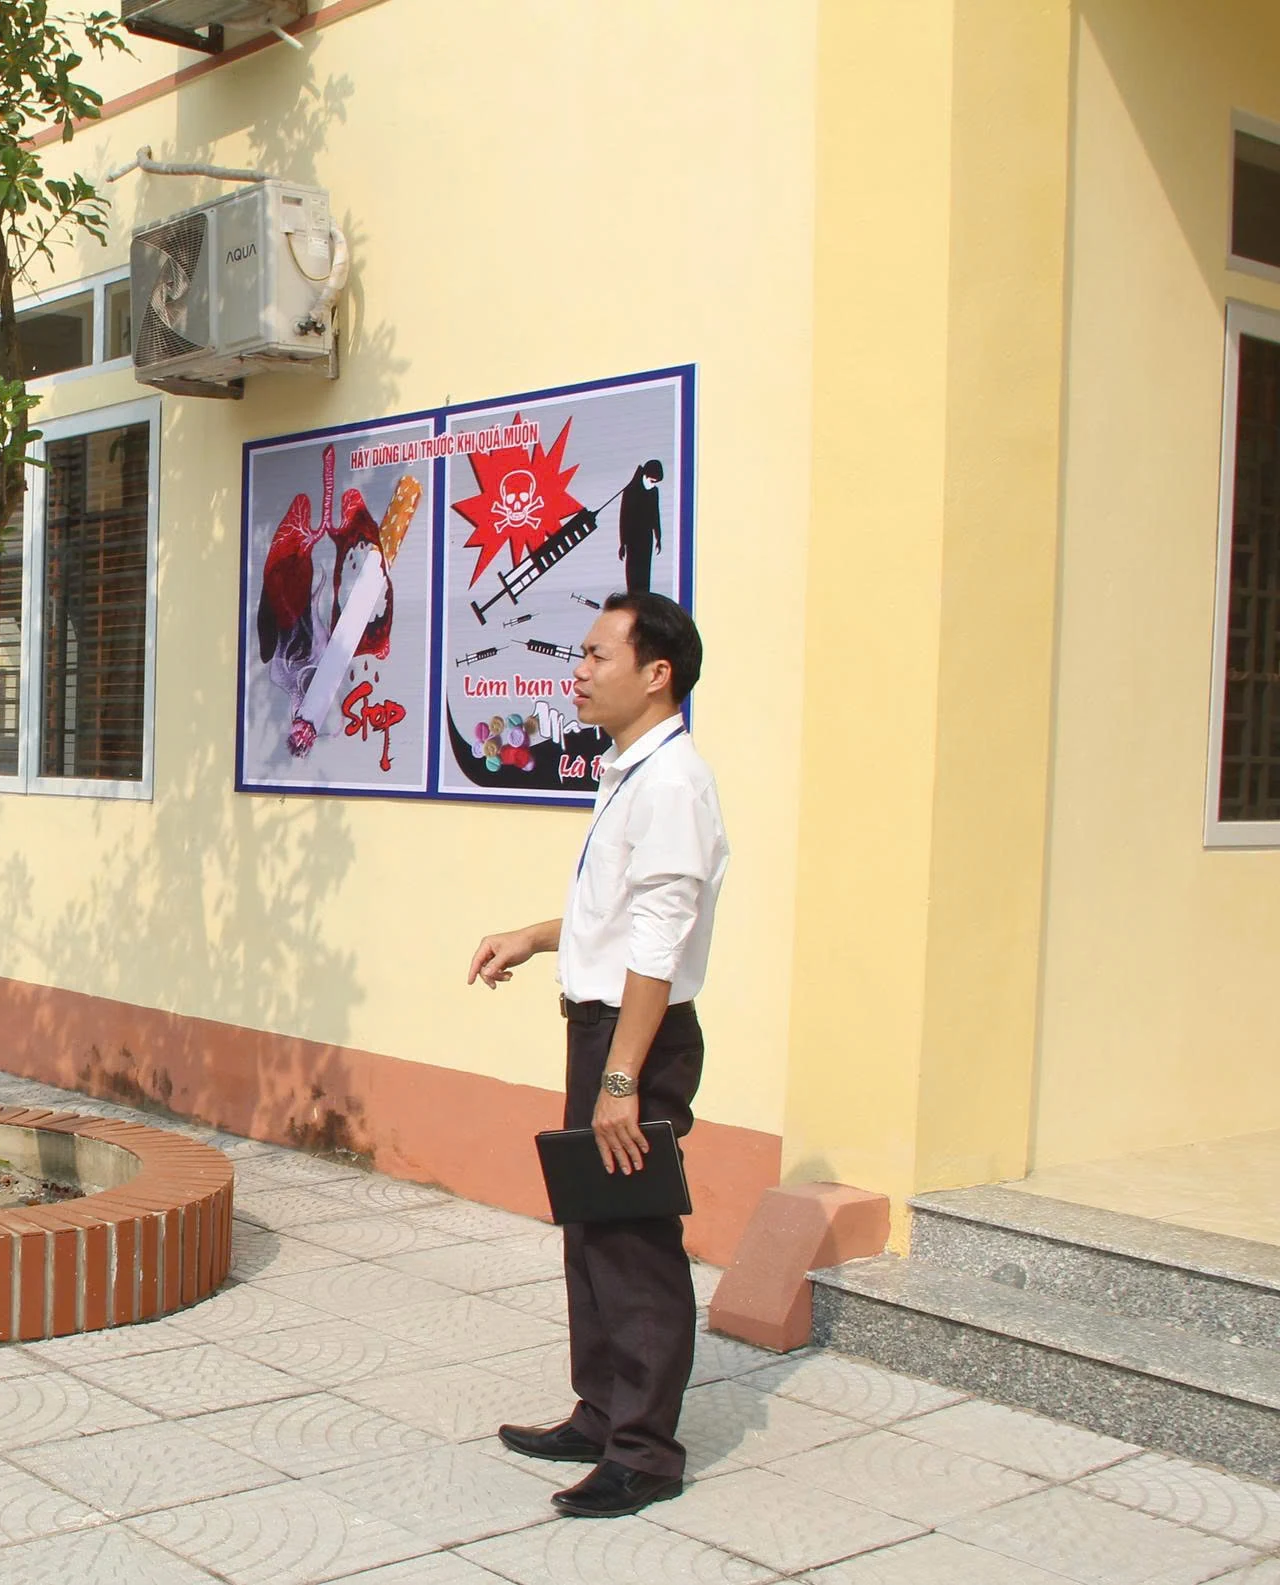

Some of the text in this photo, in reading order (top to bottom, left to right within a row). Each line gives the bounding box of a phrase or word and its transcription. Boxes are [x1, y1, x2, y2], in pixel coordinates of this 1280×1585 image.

[226, 244, 257, 264] AQUA
[351, 421, 539, 470] HÃY DỪNG LẠI TRƯỚC KHI QUÁ MUỘN
[464, 675, 508, 697] Làm
[514, 674, 553, 700] bạn
[560, 754, 586, 777] Là
